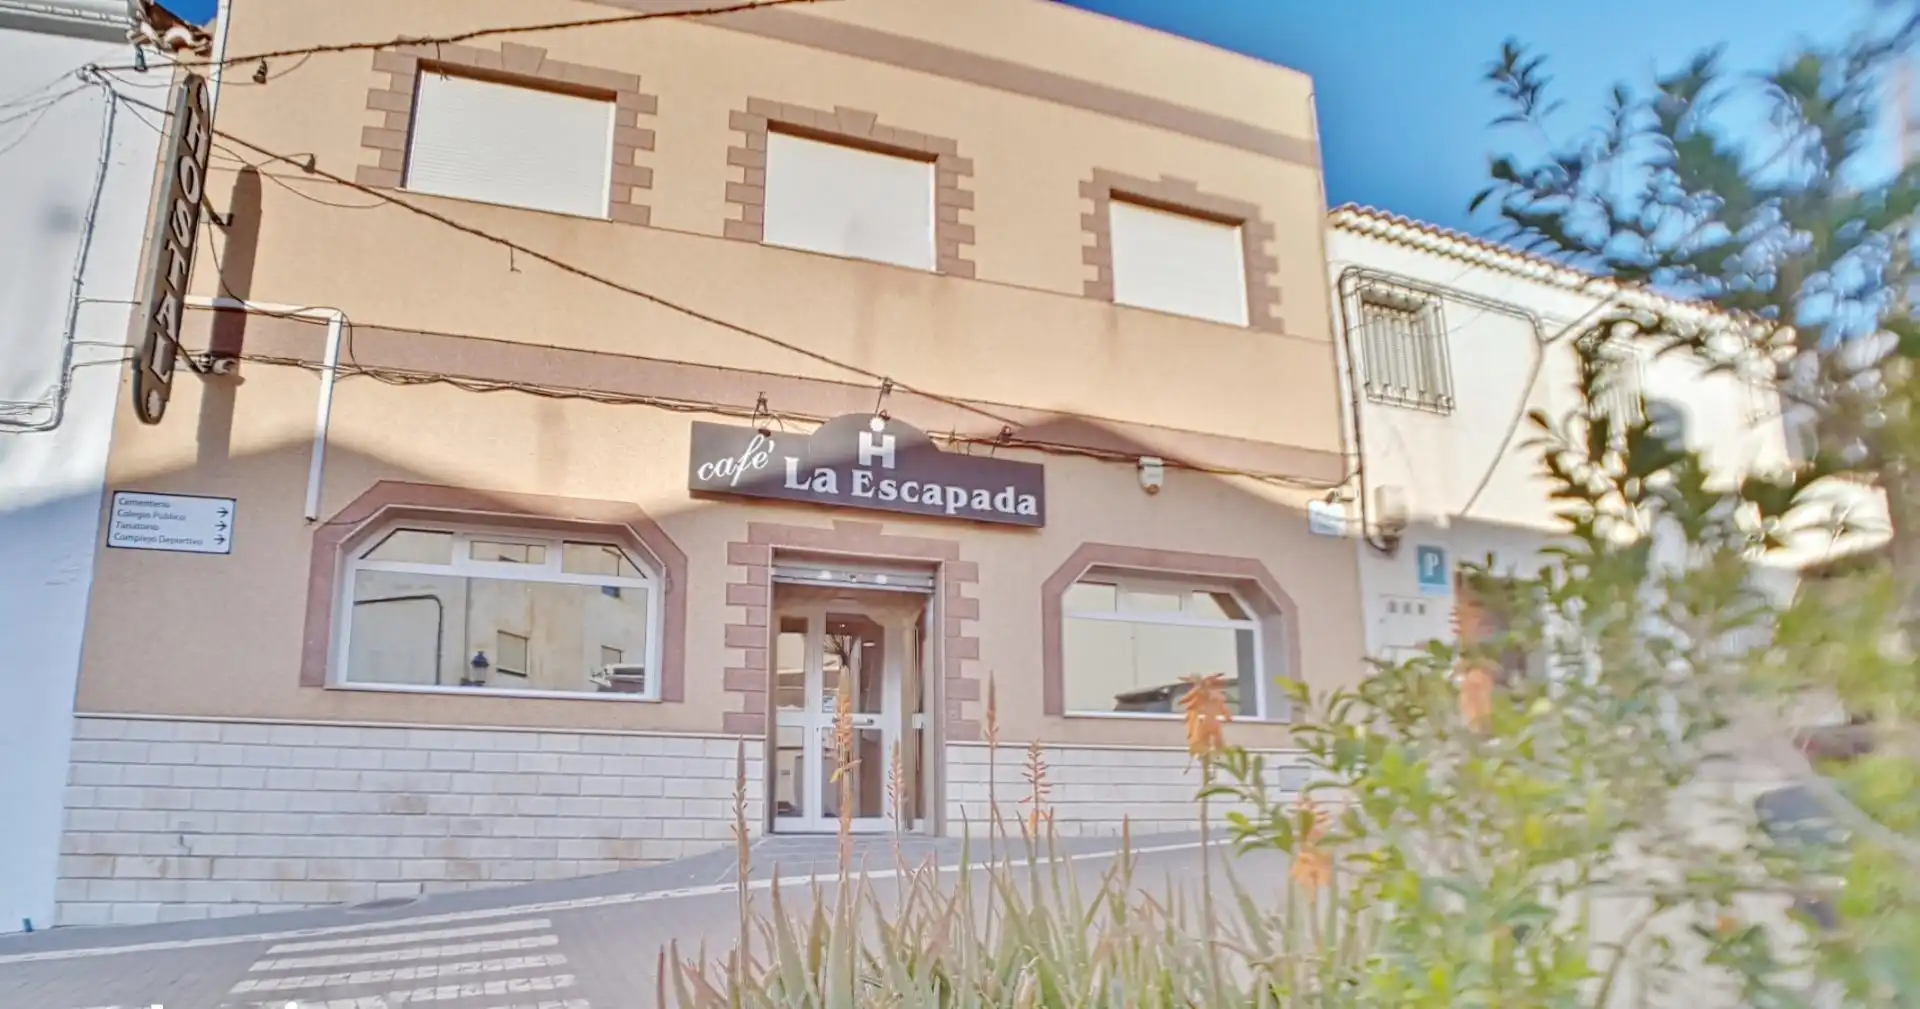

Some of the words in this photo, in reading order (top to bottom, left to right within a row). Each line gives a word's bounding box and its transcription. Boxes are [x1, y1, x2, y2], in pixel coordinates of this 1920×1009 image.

[150, 105, 208, 385] HOSTAL
[783, 456, 839, 495] La
[851, 469, 1038, 516] Escapada
[1423, 552, 1440, 576] P
